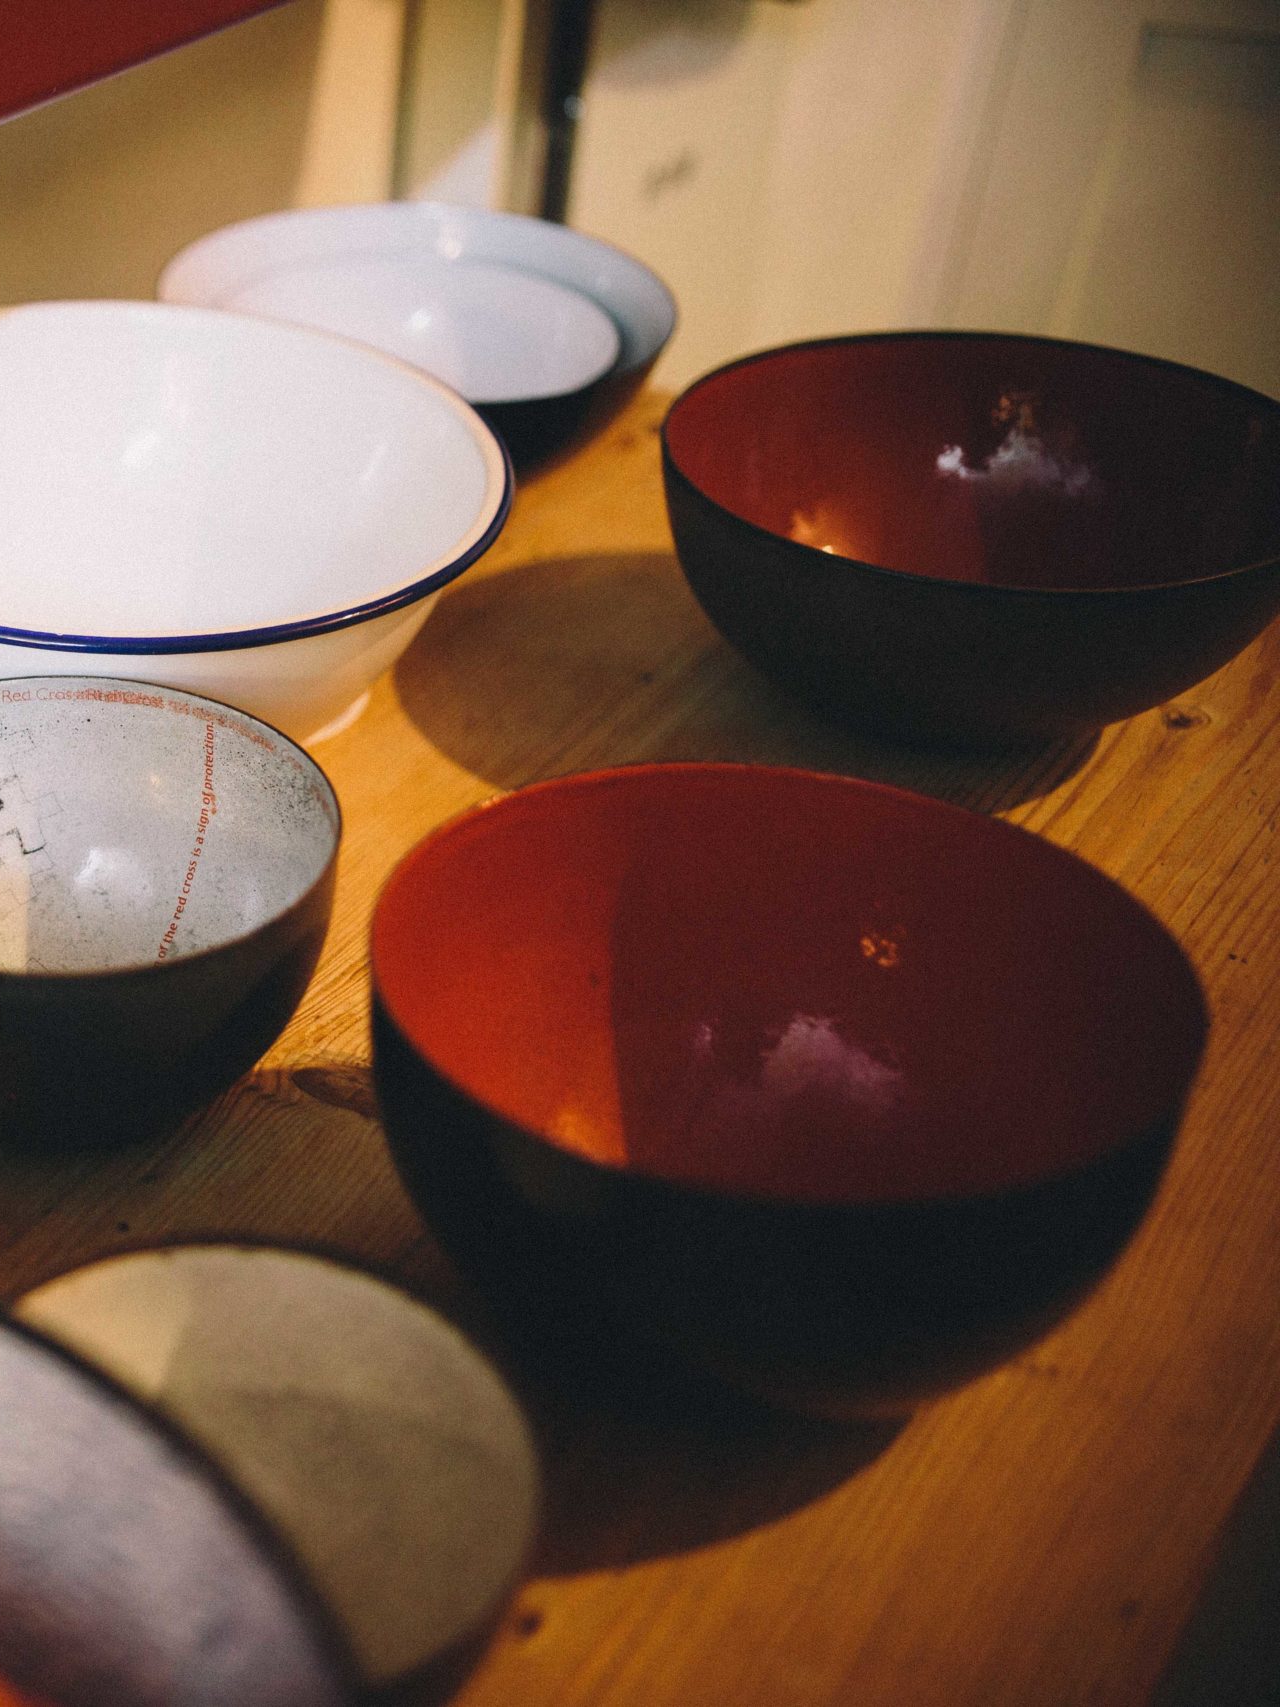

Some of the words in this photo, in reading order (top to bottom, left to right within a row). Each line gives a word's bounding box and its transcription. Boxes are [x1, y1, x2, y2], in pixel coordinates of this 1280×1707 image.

[1, 689, 31, 703] Red
[204, 720, 215, 791] protection.
[201, 791, 211, 805] of
[197, 808, 210, 834] sign
[195, 836, 204, 845] a
[190, 847, 202, 857] is
[181, 860, 198, 894] cross
[173, 896, 187, 920] red
[163, 922, 178, 943] the
[158, 943, 169, 958] of
